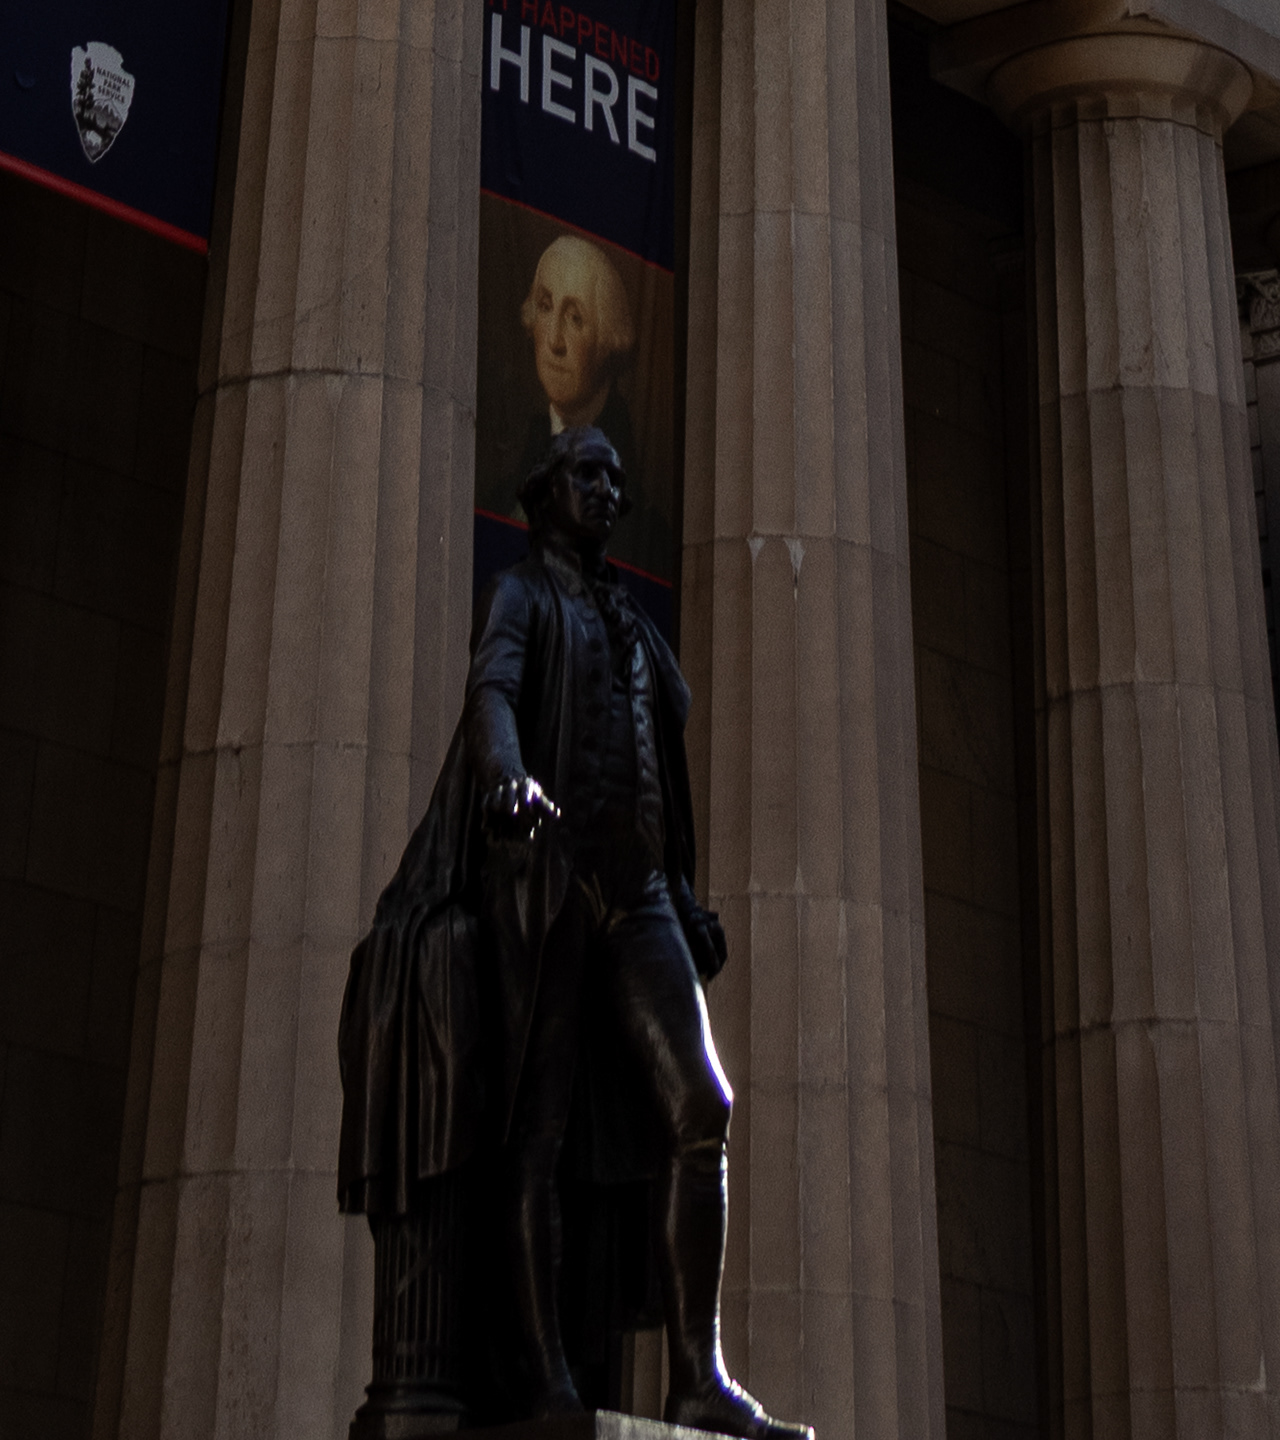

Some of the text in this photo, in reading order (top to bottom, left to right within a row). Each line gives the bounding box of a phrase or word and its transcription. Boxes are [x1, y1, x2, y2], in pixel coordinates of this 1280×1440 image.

[96, 67, 131, 88] NATIONAL
[103, 78, 122, 93] PARK
[97, 85, 125, 104] SERVICE
[489, 12, 659, 164] HERE
